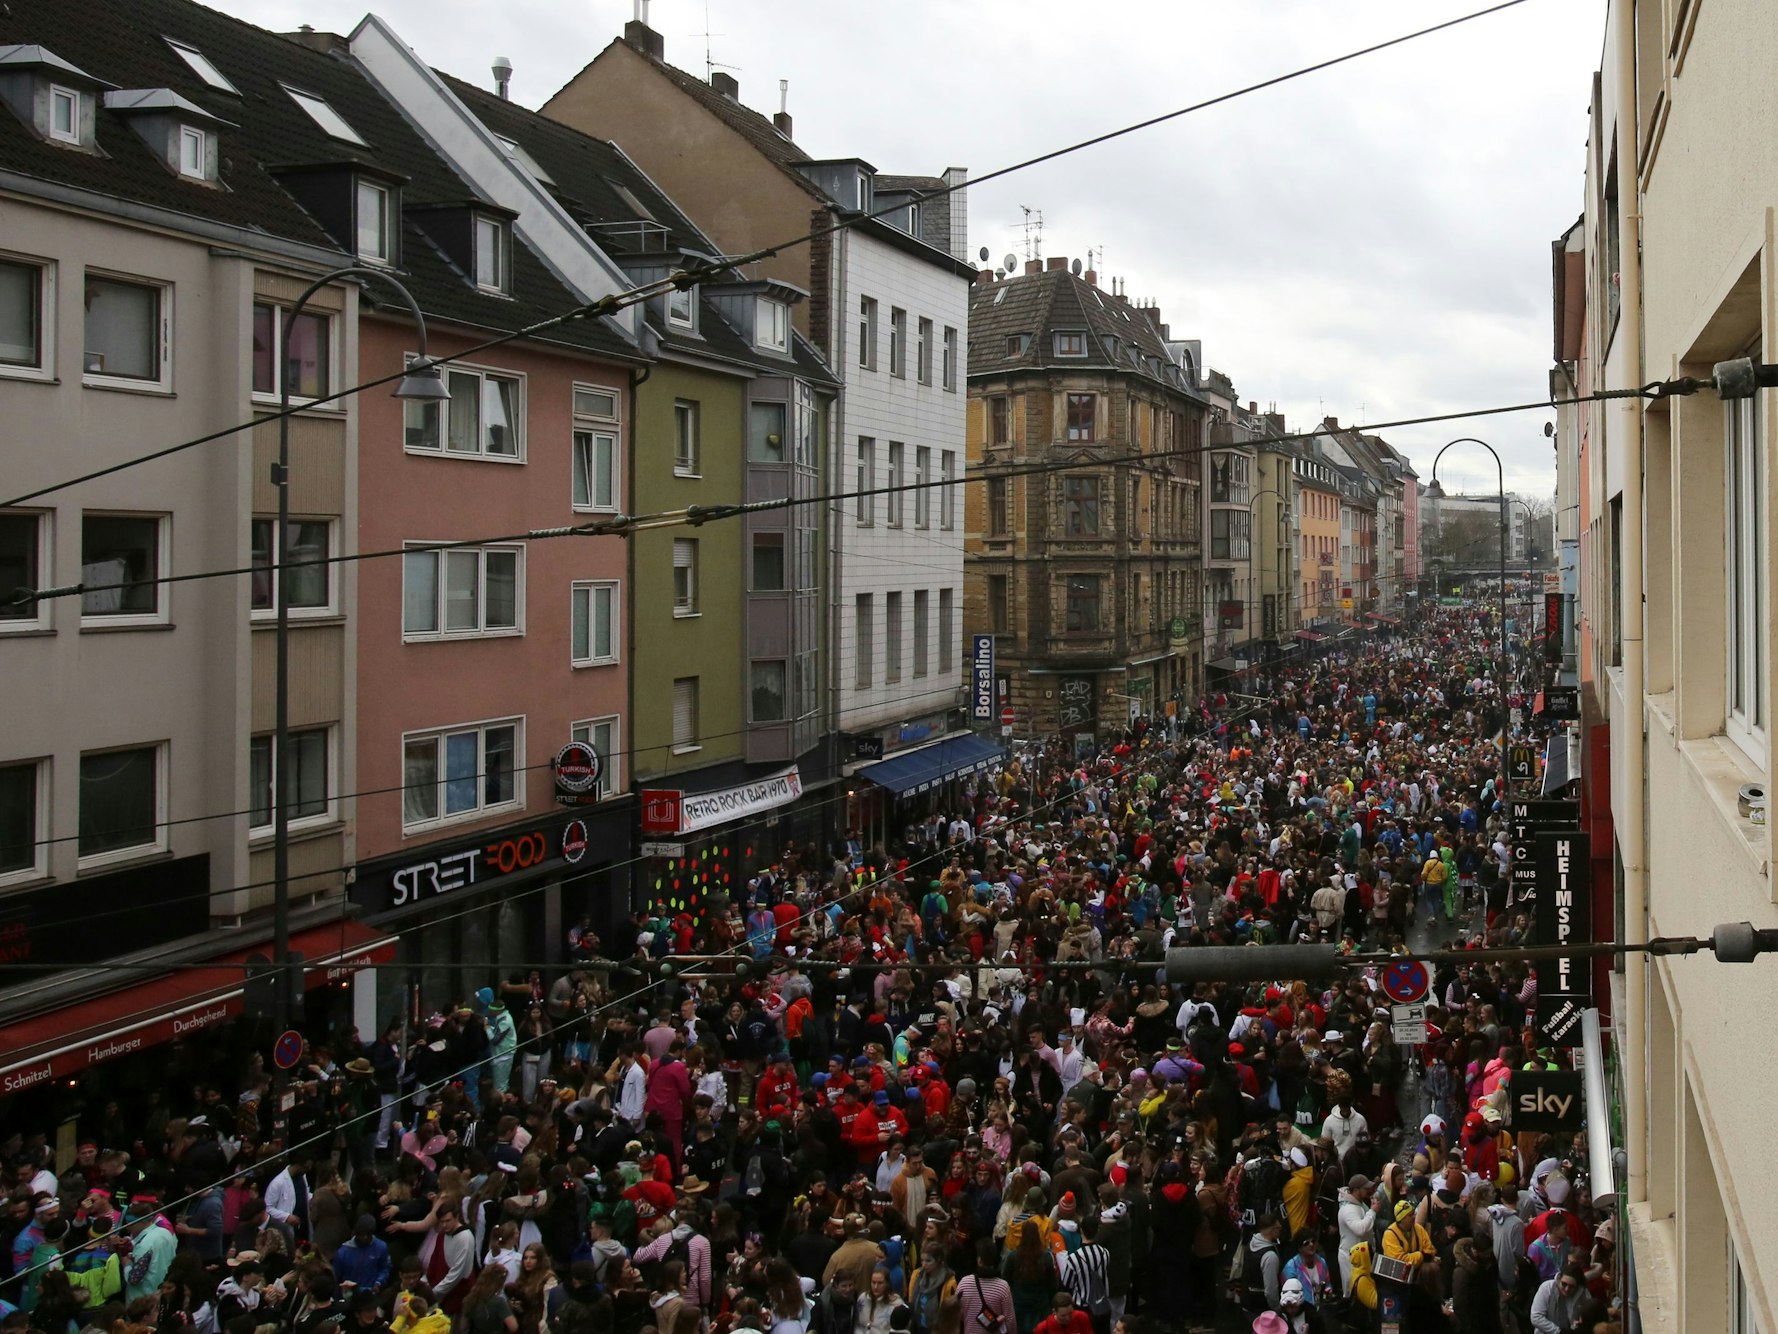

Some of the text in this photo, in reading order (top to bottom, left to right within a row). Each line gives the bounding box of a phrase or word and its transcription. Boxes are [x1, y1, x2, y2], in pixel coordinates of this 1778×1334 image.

[975, 638, 991, 717] Borsalino
[858, 742, 878, 756] sky
[561, 766, 591, 774] TURKISH
[686, 779, 787, 820] RETRO ROCK BAR 1970
[1514, 805, 1527, 817] M
[1515, 826, 1526, 838] T
[1515, 847, 1527, 860] C
[917, 1012, 936, 1023] NIKE
[1541, 1000, 1574, 1034] Fußball
[1551, 1007, 1586, 1041] Karaoke
[4, 1005, 227, 1092] Schnitzel Hamburger Durchgehend
[1519, 1086, 1574, 1119] sky
[300, 1119, 316, 1130] SWAT
